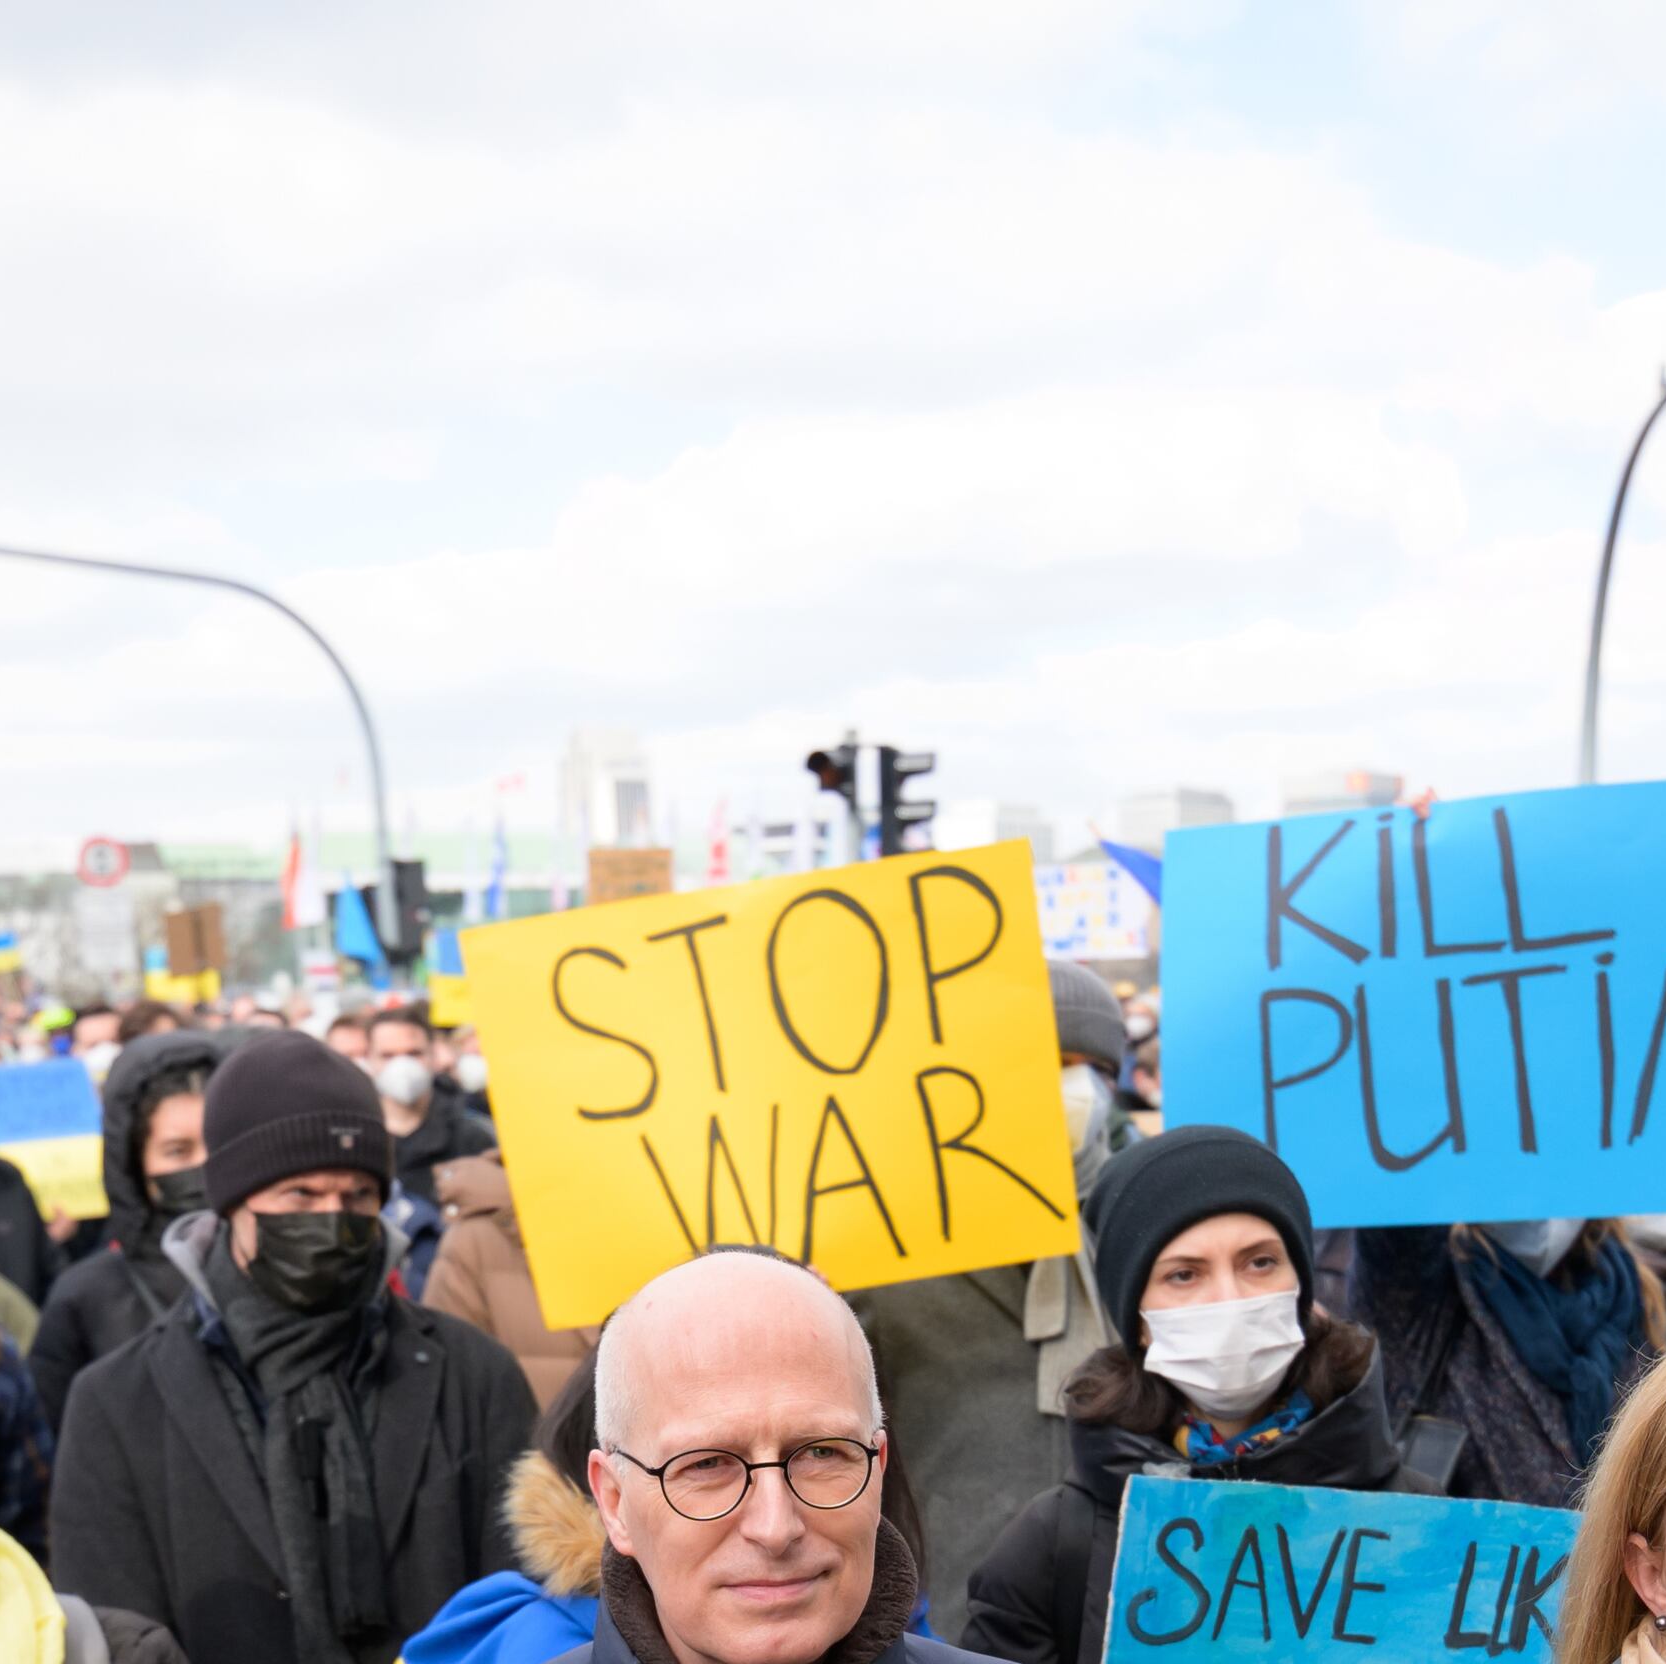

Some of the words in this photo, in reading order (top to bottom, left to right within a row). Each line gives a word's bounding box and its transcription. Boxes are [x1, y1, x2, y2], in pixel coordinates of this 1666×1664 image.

[551, 863, 1004, 1121] STOP
[640, 1066, 1066, 1267] WAR
[1126, 1516, 1395, 1647] SAVE
